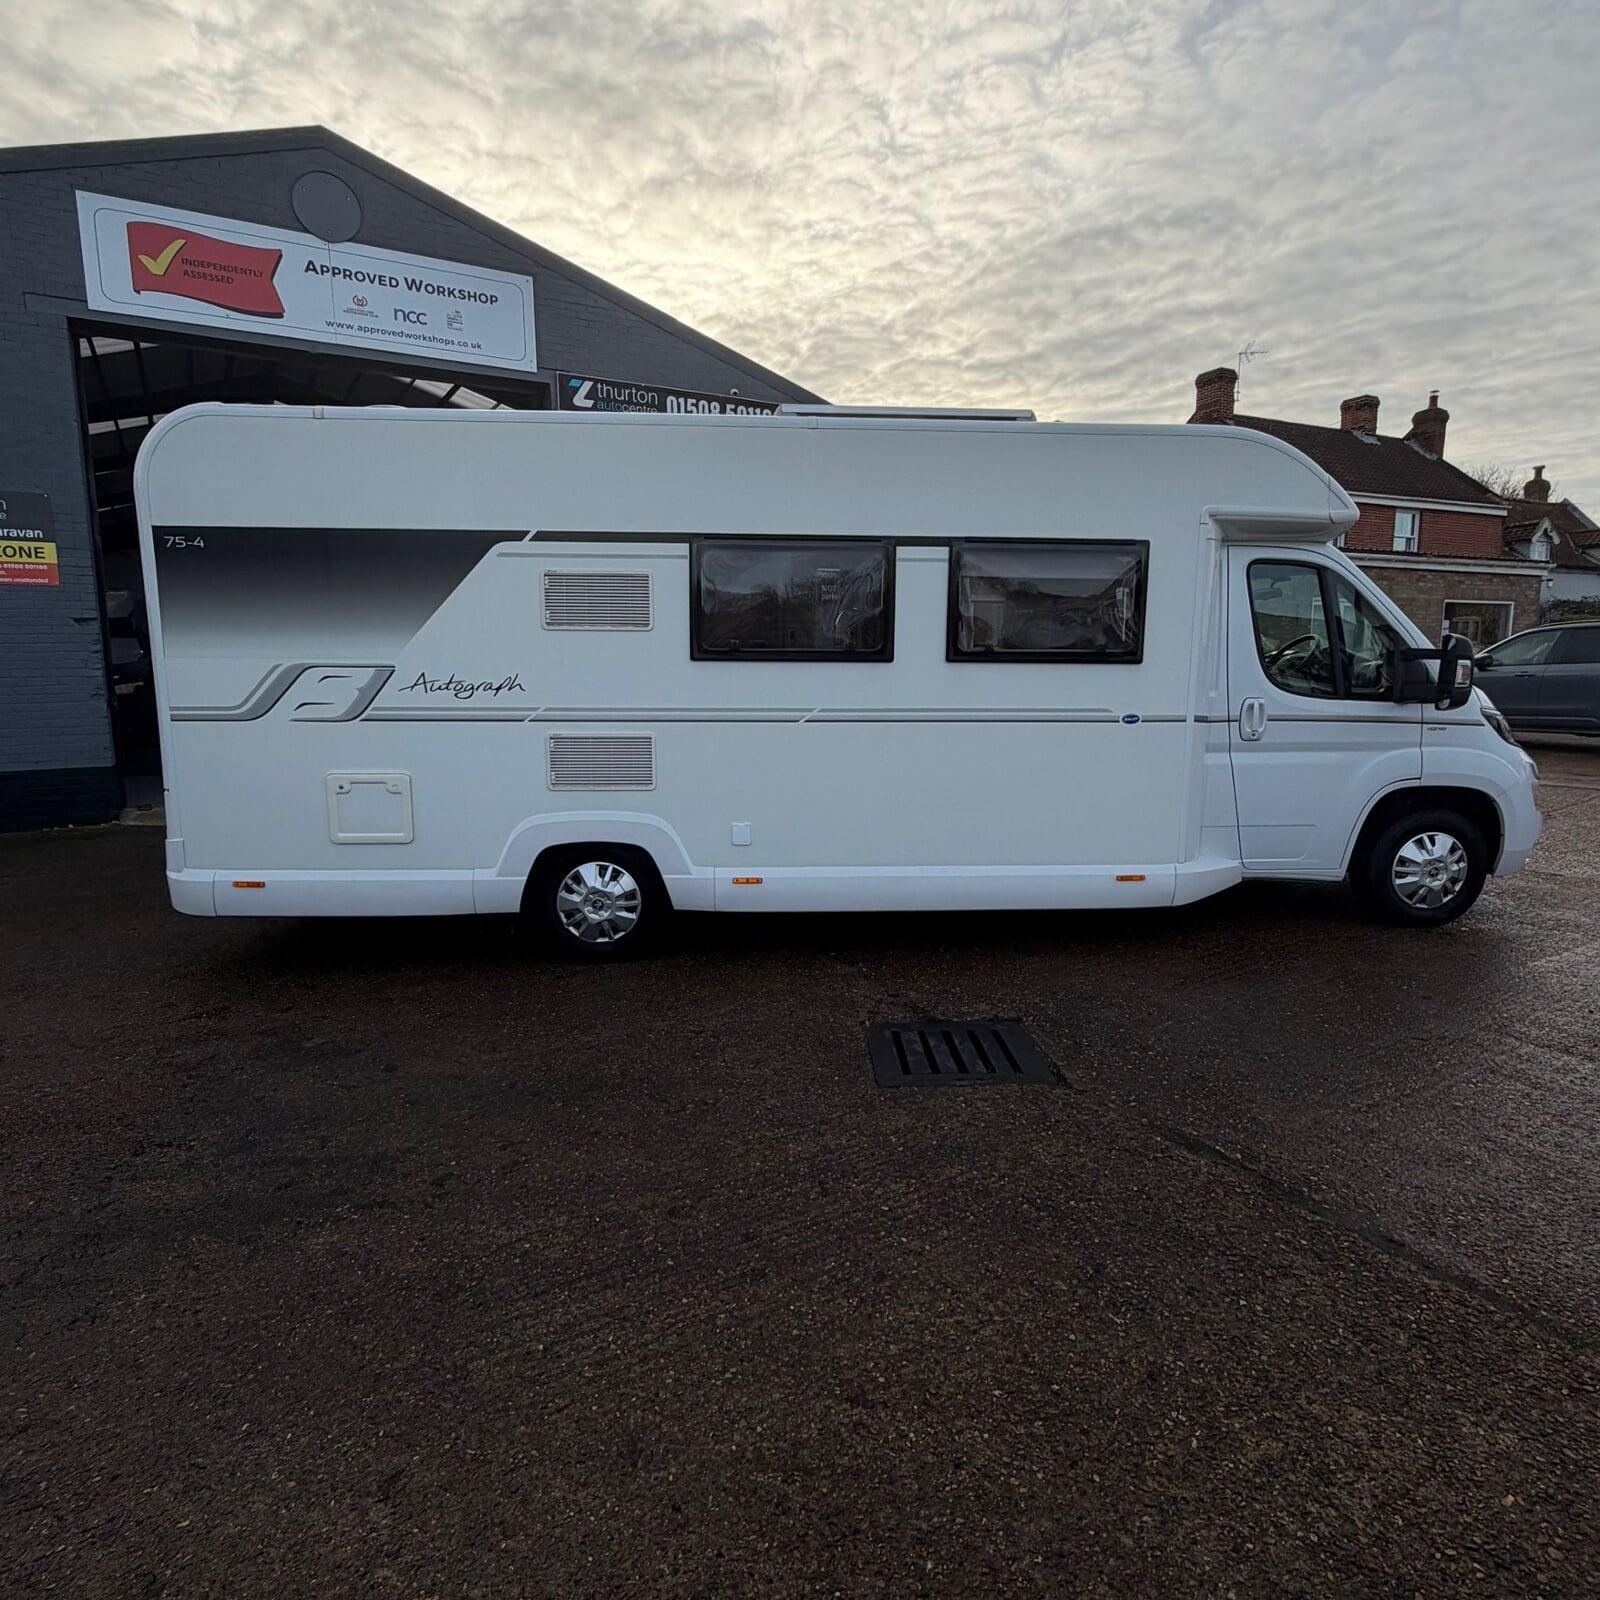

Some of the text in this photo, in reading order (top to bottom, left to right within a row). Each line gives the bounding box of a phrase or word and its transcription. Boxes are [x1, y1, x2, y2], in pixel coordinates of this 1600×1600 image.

[181, 257, 264, 278] INDEPENDENTLY
[183, 269, 234, 284] ASSESSED
[393, 307, 428, 326] ncc
[325, 320, 482, 350] www.approvedworkshops.co.uk
[597, 382, 658, 405] thurton
[163, 536, 205, 548] 75-4
[398, 672, 526, 700] Autograph
